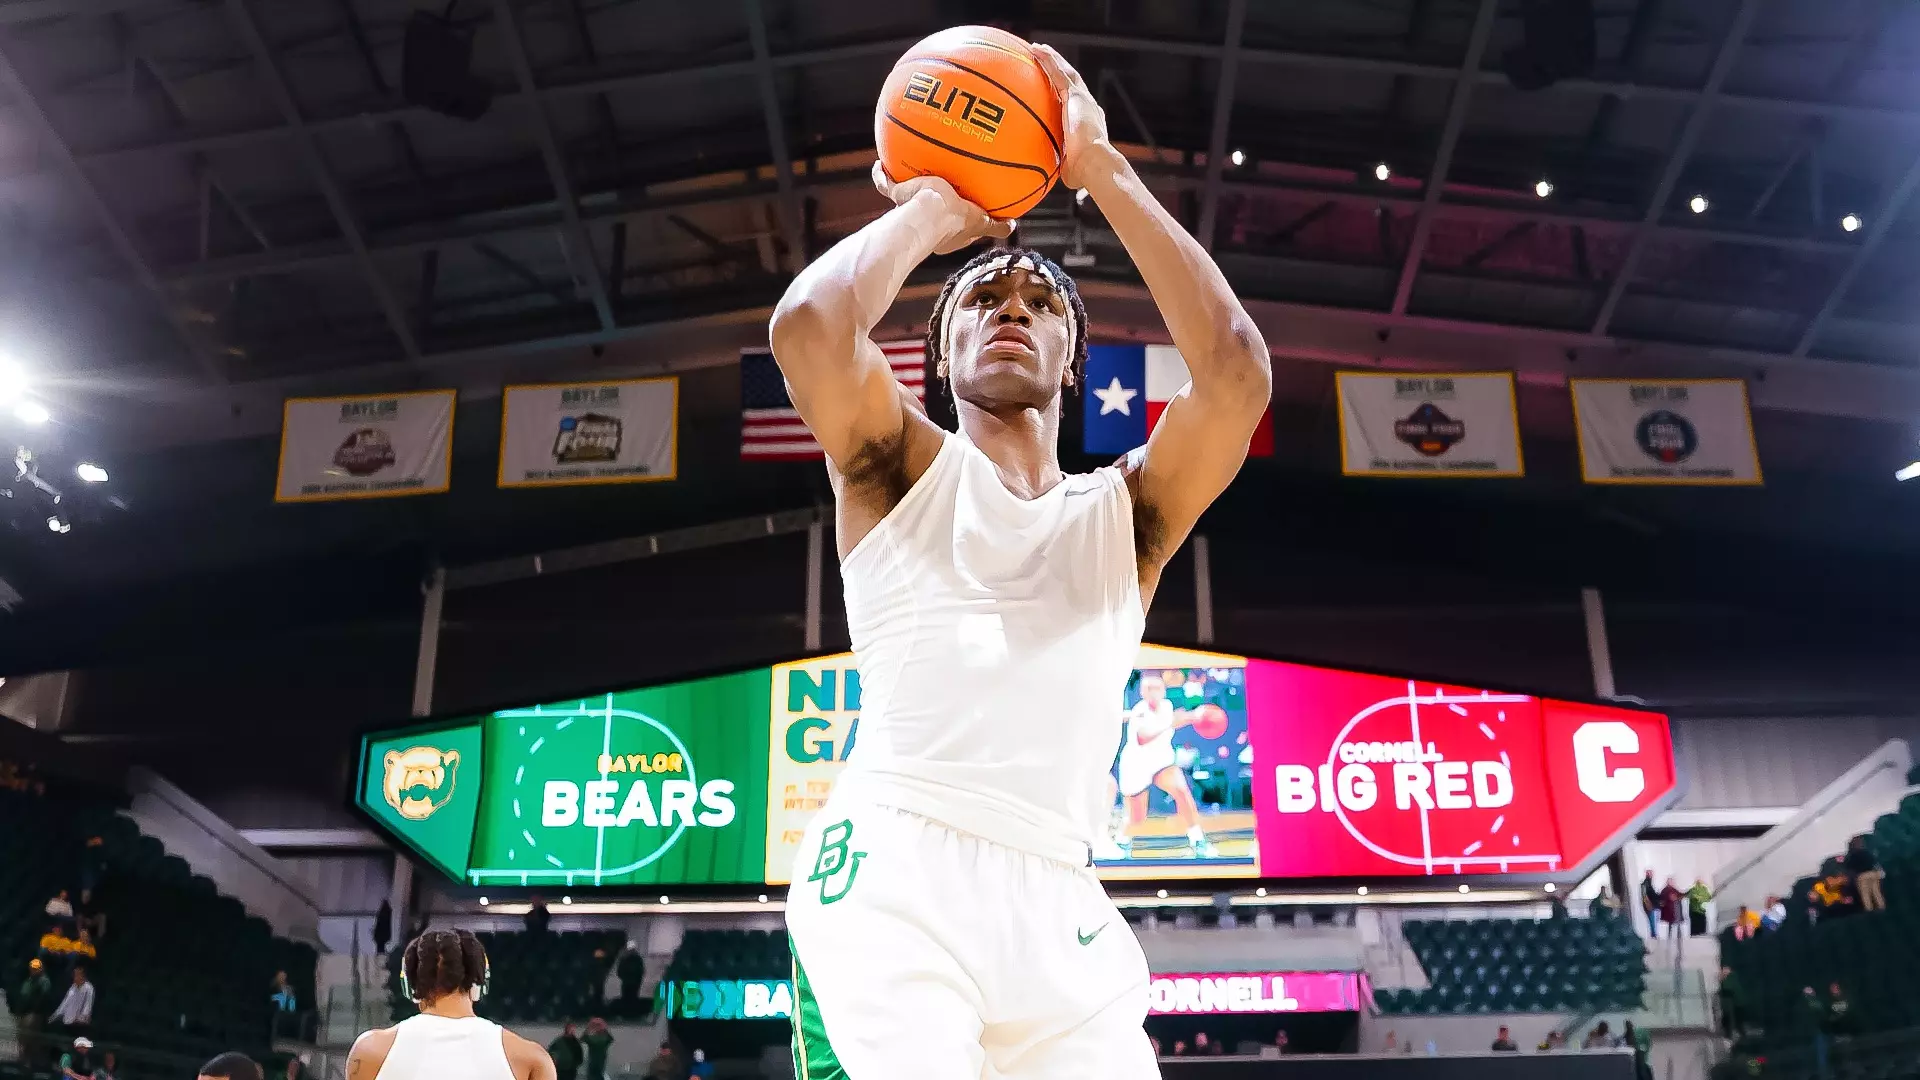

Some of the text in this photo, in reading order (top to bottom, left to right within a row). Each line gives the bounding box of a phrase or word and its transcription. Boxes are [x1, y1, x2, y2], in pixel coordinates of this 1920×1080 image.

[900, 102, 994, 143] CHPIONSHIP
[903, 72, 1006, 136] ELITE
[597, 752, 684, 774] BAYLOR
[1339, 741, 1444, 764] CORNELL
[1572, 721, 1645, 803] C
[541, 779, 736, 828] BEARS
[1275, 760, 1514, 813] BIG RED
[807, 818, 868, 905] BU
[1149, 976, 1299, 1013] ORNELL
